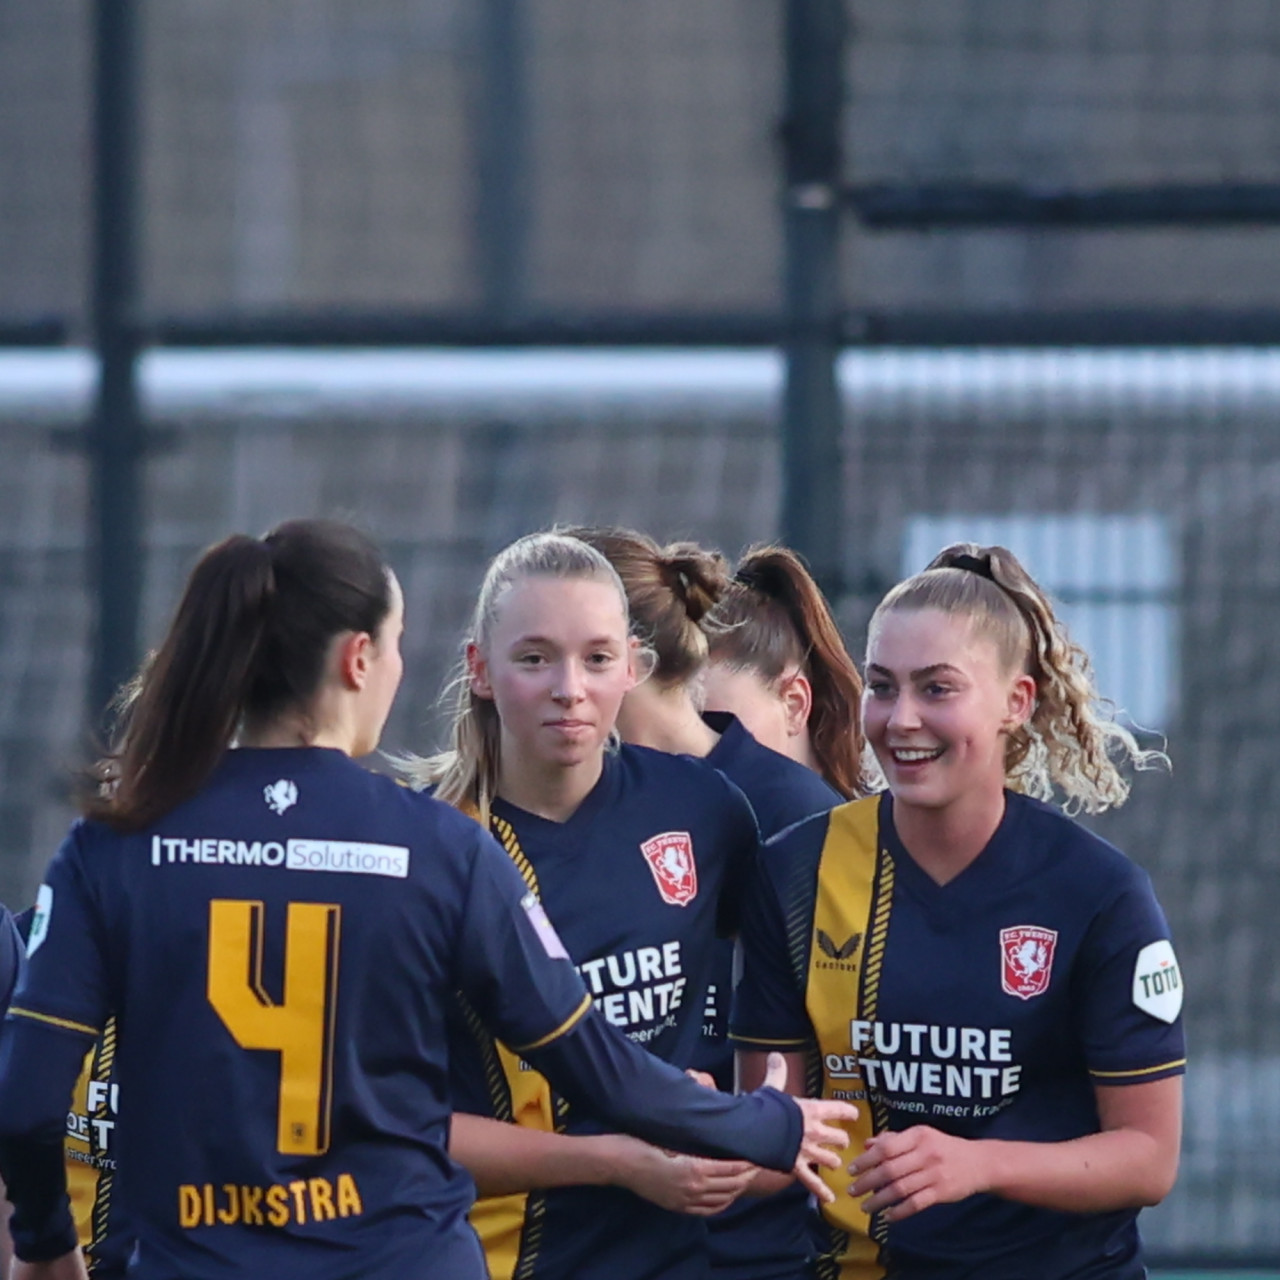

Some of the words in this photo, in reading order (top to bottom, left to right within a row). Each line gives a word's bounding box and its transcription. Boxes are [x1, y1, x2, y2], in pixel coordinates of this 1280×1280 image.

[575, 941, 682, 994] TURE
[1139, 966, 1179, 999] TOTO
[594, 977, 687, 1026] ENTE
[207, 898, 341, 1156] 4
[851, 1020, 1013, 1062] FUTURE
[826, 1055, 857, 1072] OF
[858, 1058, 1022, 1099] TWENTE
[933, 1104, 969, 1117] meer
[178, 1173, 363, 1228] DIJKSTRA
